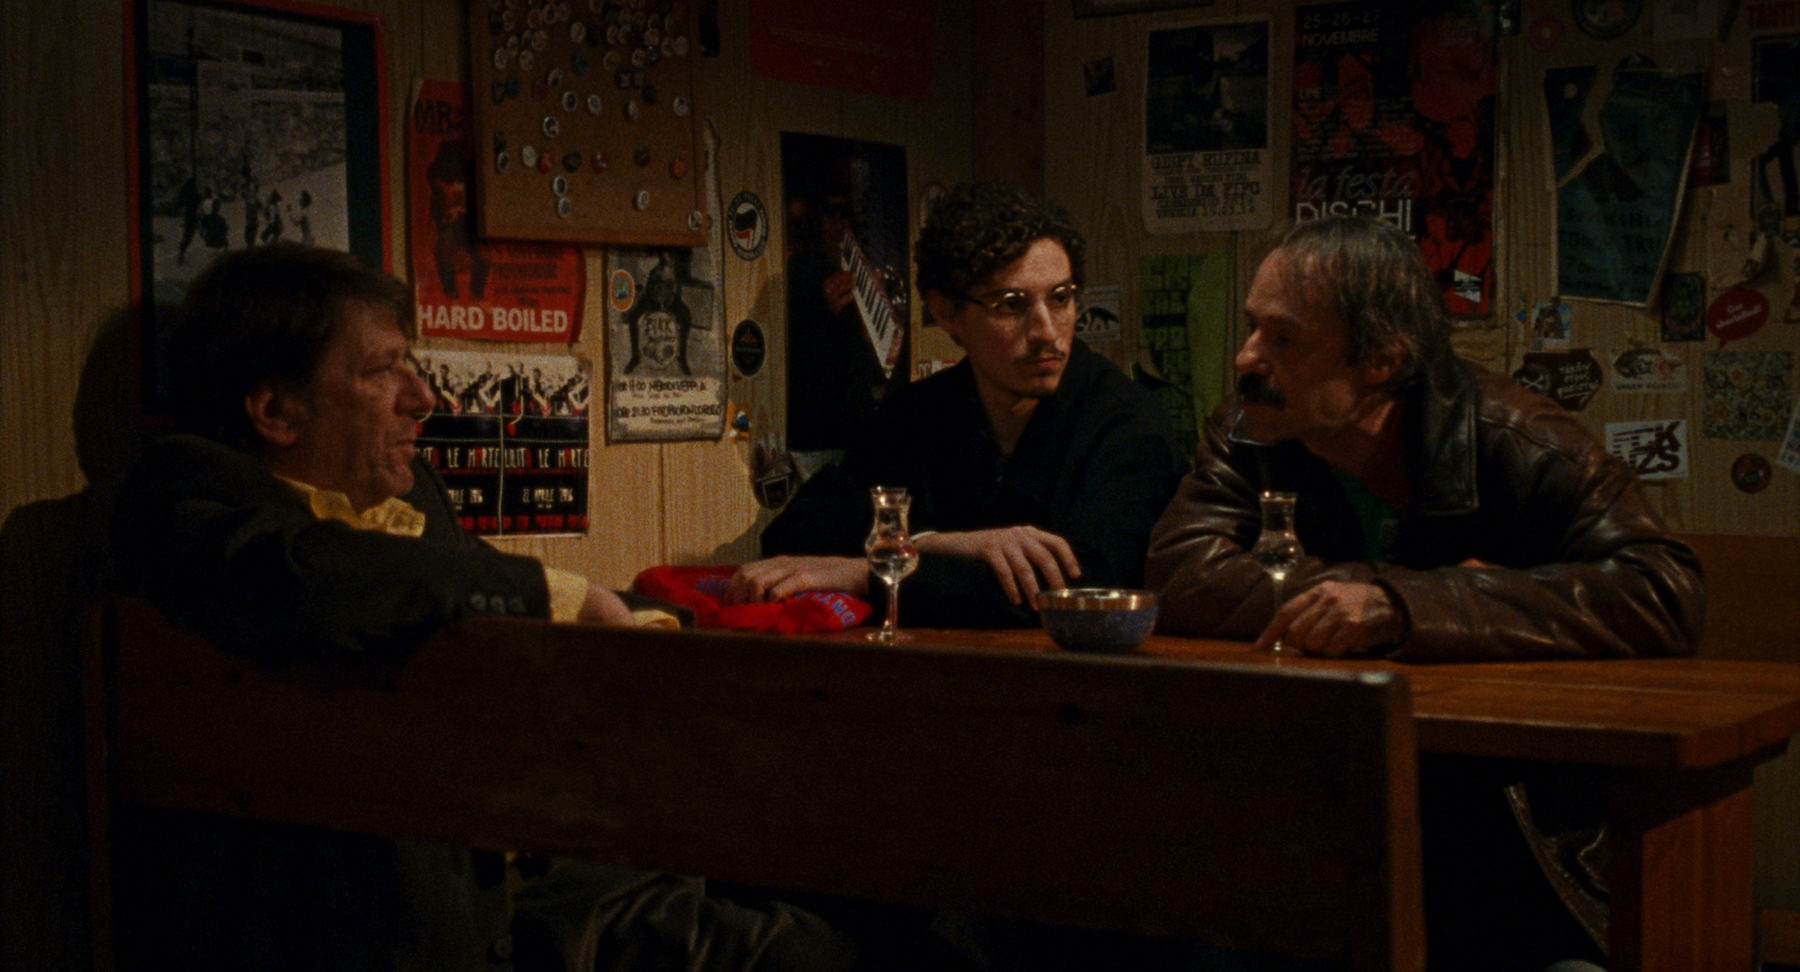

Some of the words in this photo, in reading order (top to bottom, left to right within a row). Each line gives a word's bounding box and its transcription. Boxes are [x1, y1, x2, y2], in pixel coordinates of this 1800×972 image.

[1302, 28, 1380, 48] NOVEMBRE
[1334, 164, 1414, 200] festa
[418, 304, 485, 331] HARD
[491, 306, 569, 333] BOILED
